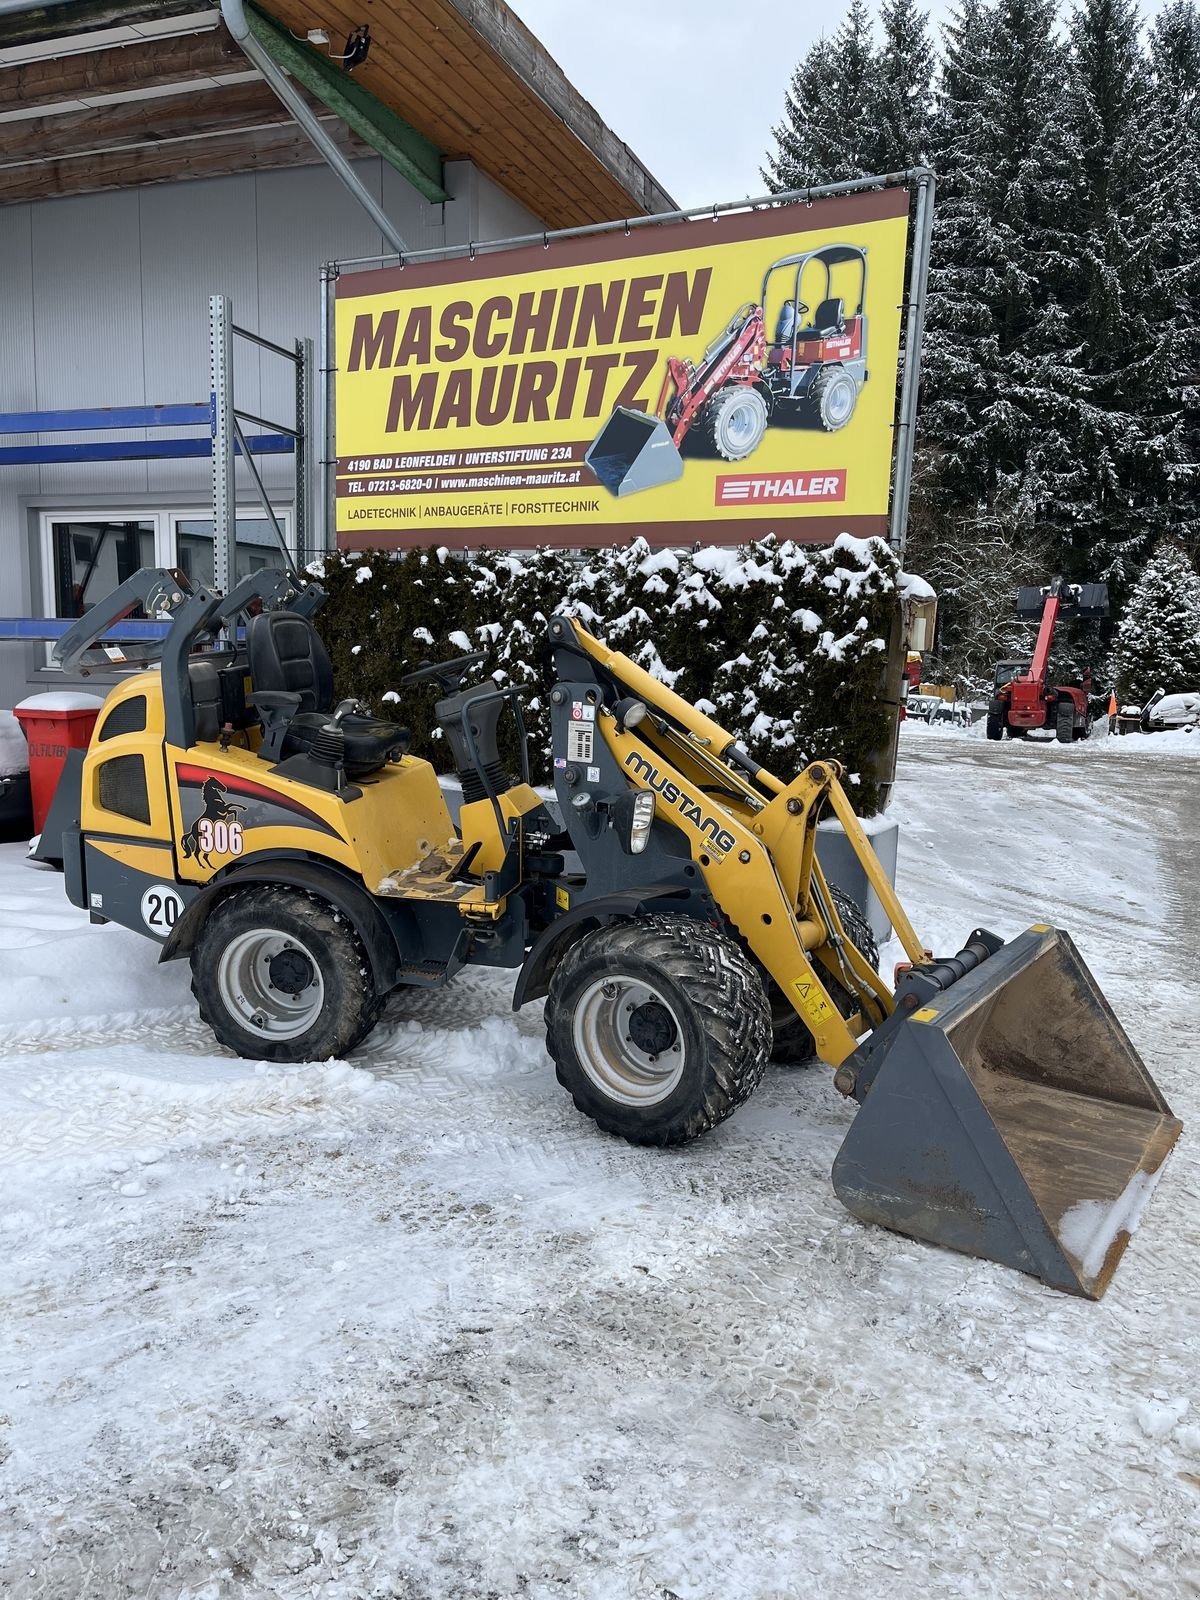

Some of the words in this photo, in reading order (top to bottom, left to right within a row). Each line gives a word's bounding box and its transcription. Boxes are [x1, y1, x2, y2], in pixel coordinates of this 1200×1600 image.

[347, 267, 713, 372] MASCHINEN
[385, 349, 659, 433] MAURITZ
[347, 460, 371, 471] 4190
[373, 458, 393, 470] BAD
[395, 454, 456, 469] LEONFELDEN
[465, 448, 548, 465] UNTERSTIFTUNG
[551, 446, 572, 459] 23A
[348, 481, 365, 492] TEL.
[368, 478, 432, 492] 07213-6820-0
[441, 470, 581, 488] www.maschinen-mauritz.at
[348, 507, 416, 519] LADETECHNIK
[424, 502, 503, 517] ANBAUGERÄTE
[511, 500, 600, 514] FORSTTECHNIK
[624, 751, 736, 853] MUSTANG
[199, 819, 244, 855] 306
[148, 894, 178, 928] 20
